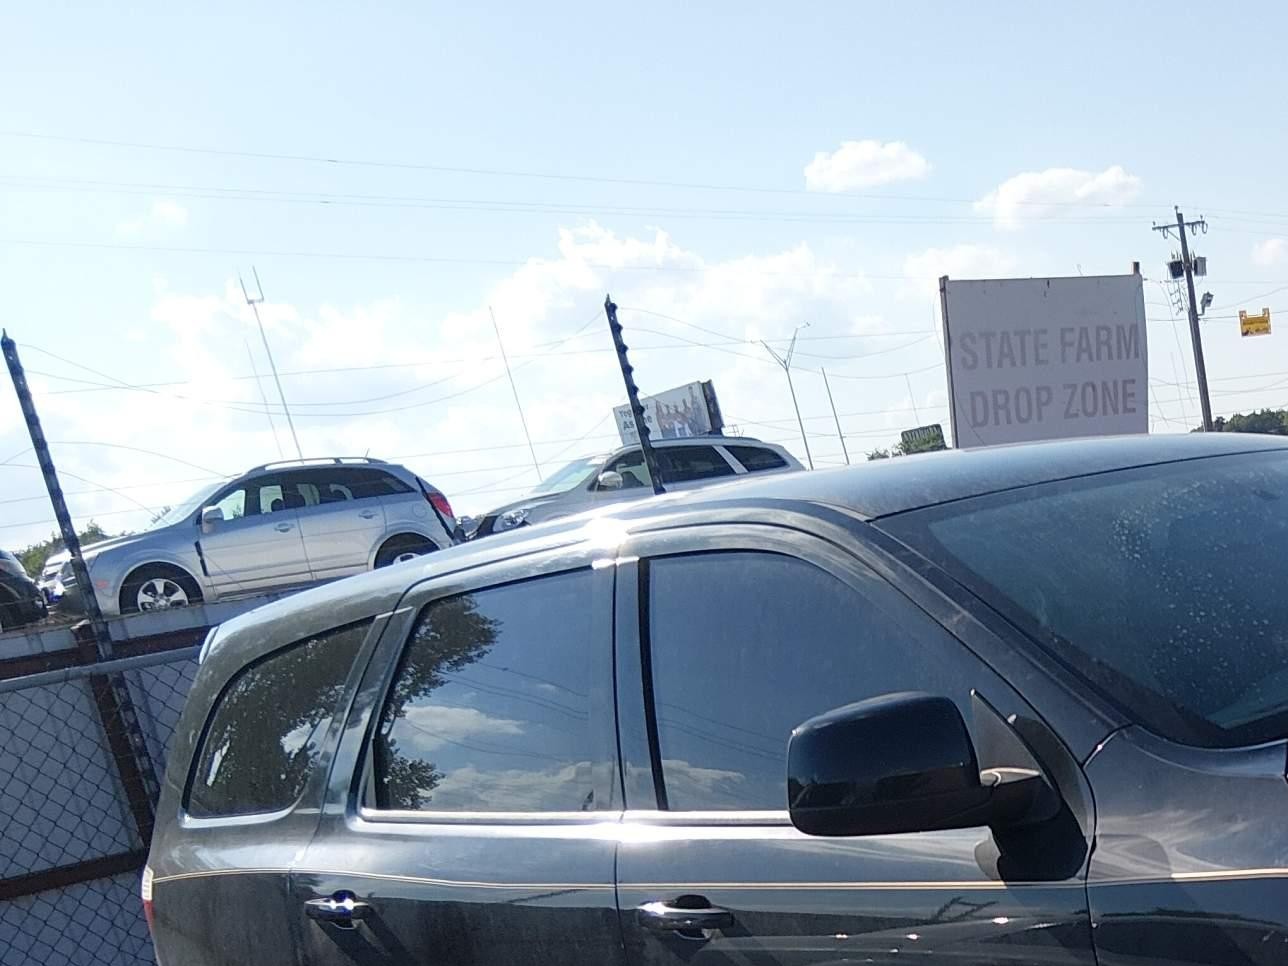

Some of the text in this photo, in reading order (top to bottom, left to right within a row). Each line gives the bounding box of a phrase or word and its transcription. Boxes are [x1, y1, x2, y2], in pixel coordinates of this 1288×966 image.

[959, 323, 1140, 370] STATE FARM
[969, 378, 1137, 428] DROP ZONE
